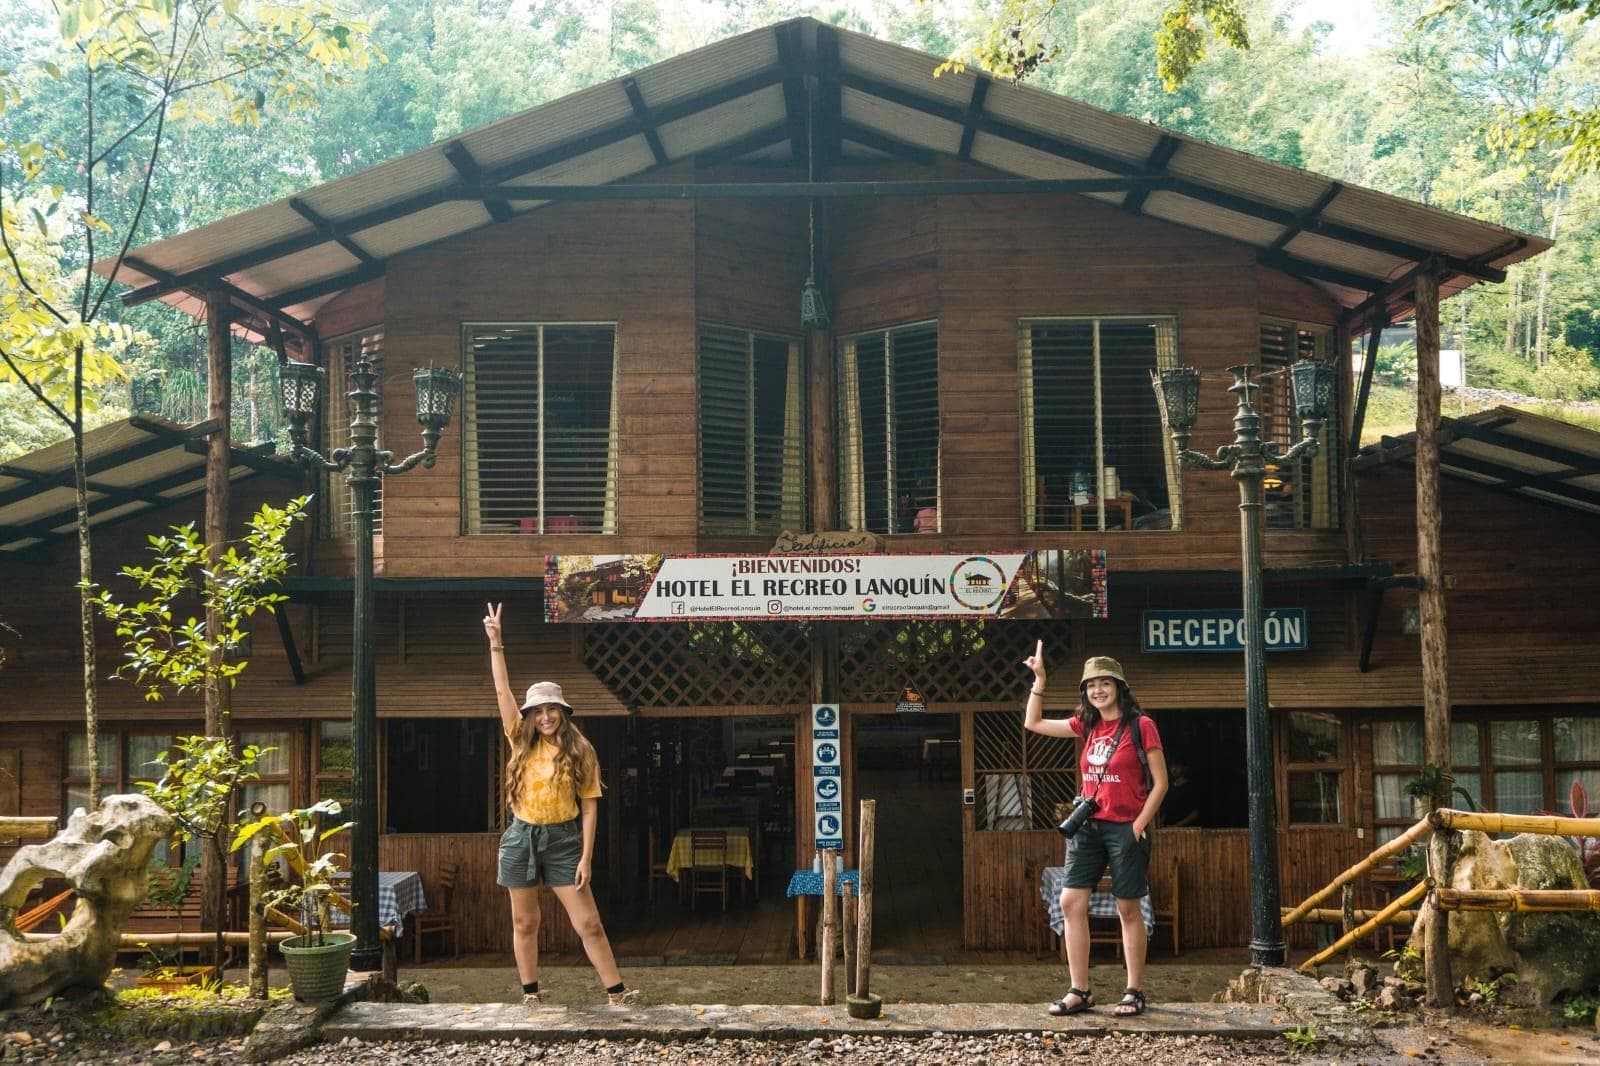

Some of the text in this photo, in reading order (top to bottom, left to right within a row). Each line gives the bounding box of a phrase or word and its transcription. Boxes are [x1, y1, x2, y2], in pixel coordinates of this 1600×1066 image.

[732, 558, 861, 577] ¡BIENVENIDOS!
[656, 574, 946, 598] HOTEL EL RECREO LANQUÍN
[1148, 611, 1300, 647] RECEPCÓN
